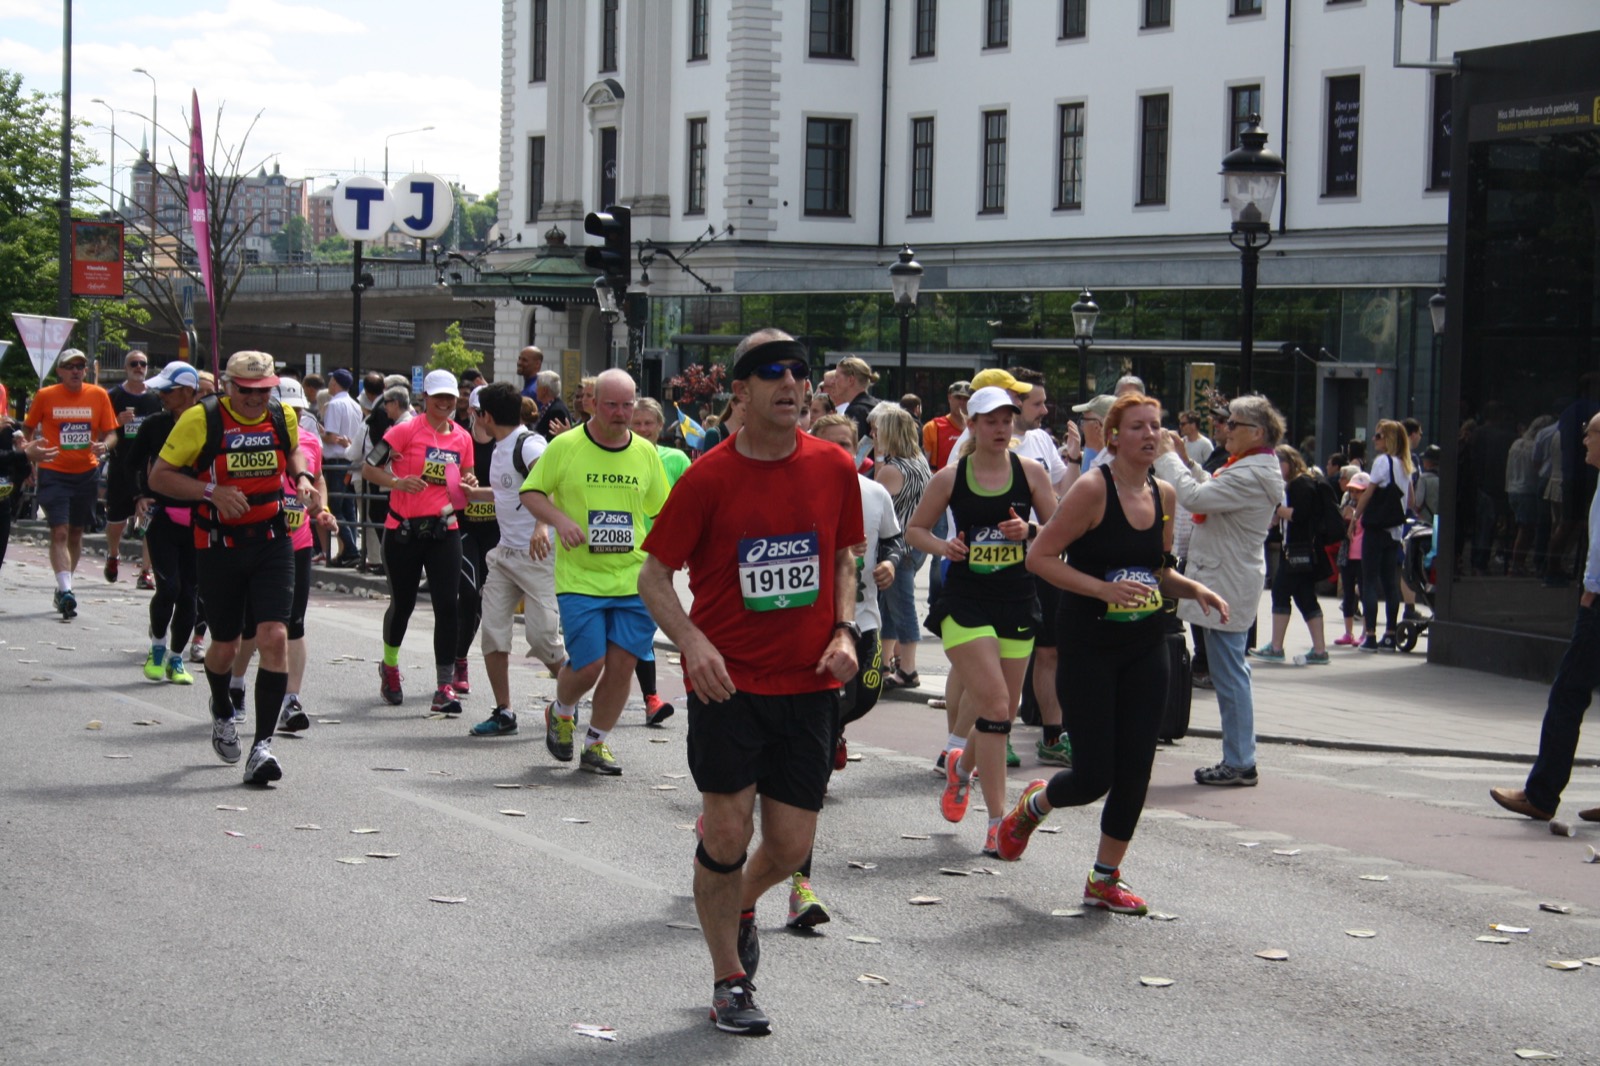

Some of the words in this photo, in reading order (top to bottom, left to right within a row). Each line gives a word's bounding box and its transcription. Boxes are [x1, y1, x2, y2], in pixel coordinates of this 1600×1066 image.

[1516, 106, 1542, 117] tunnelbana
[1544, 104, 1552, 114] och
[1554, 101, 1578, 116] pendeltåg
[1498, 122, 1516, 132] Elevator
[1524, 120, 1538, 128] Metro
[1540, 117, 1549, 128] and
[1550, 116, 1574, 126] commuter
[345, 186, 384, 230] T
[403, 182, 434, 231] J
[62, 434, 90, 443] 19223
[245, 436, 270, 446] asics
[230, 452, 274, 468] 20692
[586, 474, 599, 482] FZ
[602, 474, 638, 485] FORZA
[606, 514, 628, 524] asics
[592, 529, 632, 543] 22088
[768, 539, 810, 557] asics
[973, 546, 1017, 562] 24121
[746, 565, 814, 593] 19182
